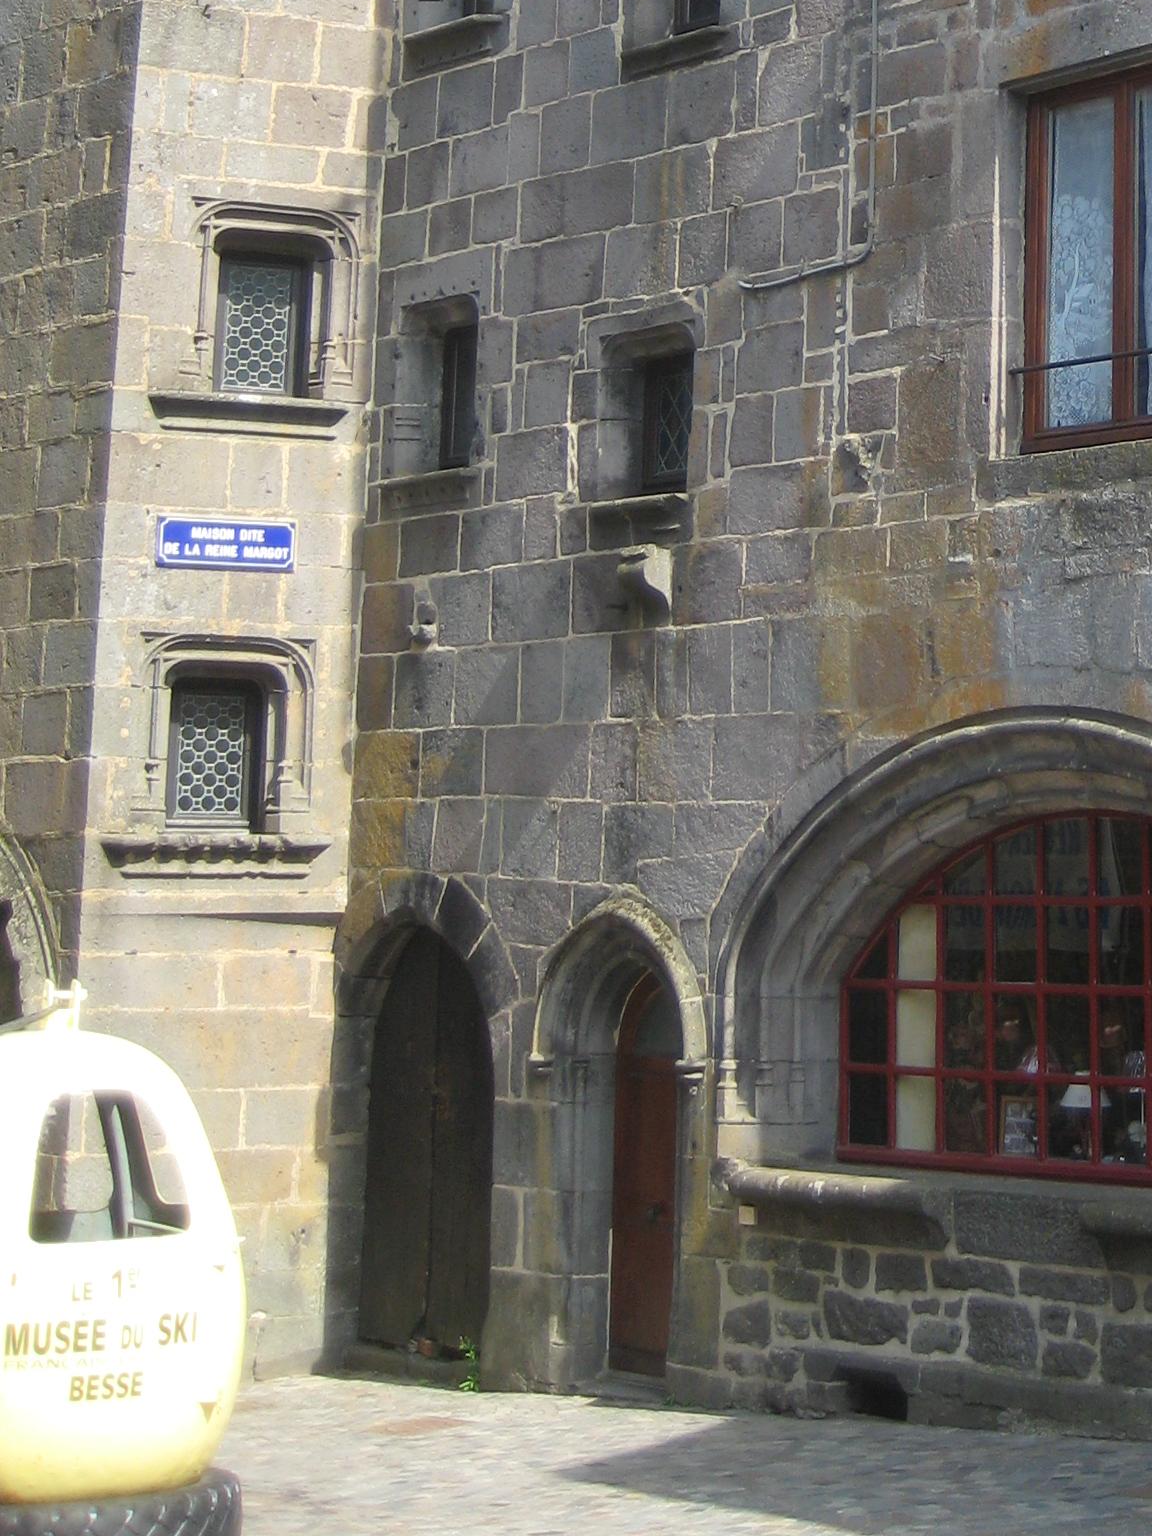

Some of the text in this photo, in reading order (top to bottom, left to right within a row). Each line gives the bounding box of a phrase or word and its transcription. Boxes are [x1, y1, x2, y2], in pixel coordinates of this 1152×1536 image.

[191, 526, 265, 543] MAISON DITE
[163, 542, 290, 560] DE LA REINE MARGOT
[71, 1281, 93, 1302] LE
[121, 1324, 144, 1349] DU
[158, 1312, 197, 1346] SKI
[69, 1371, 144, 1402] BESSE
